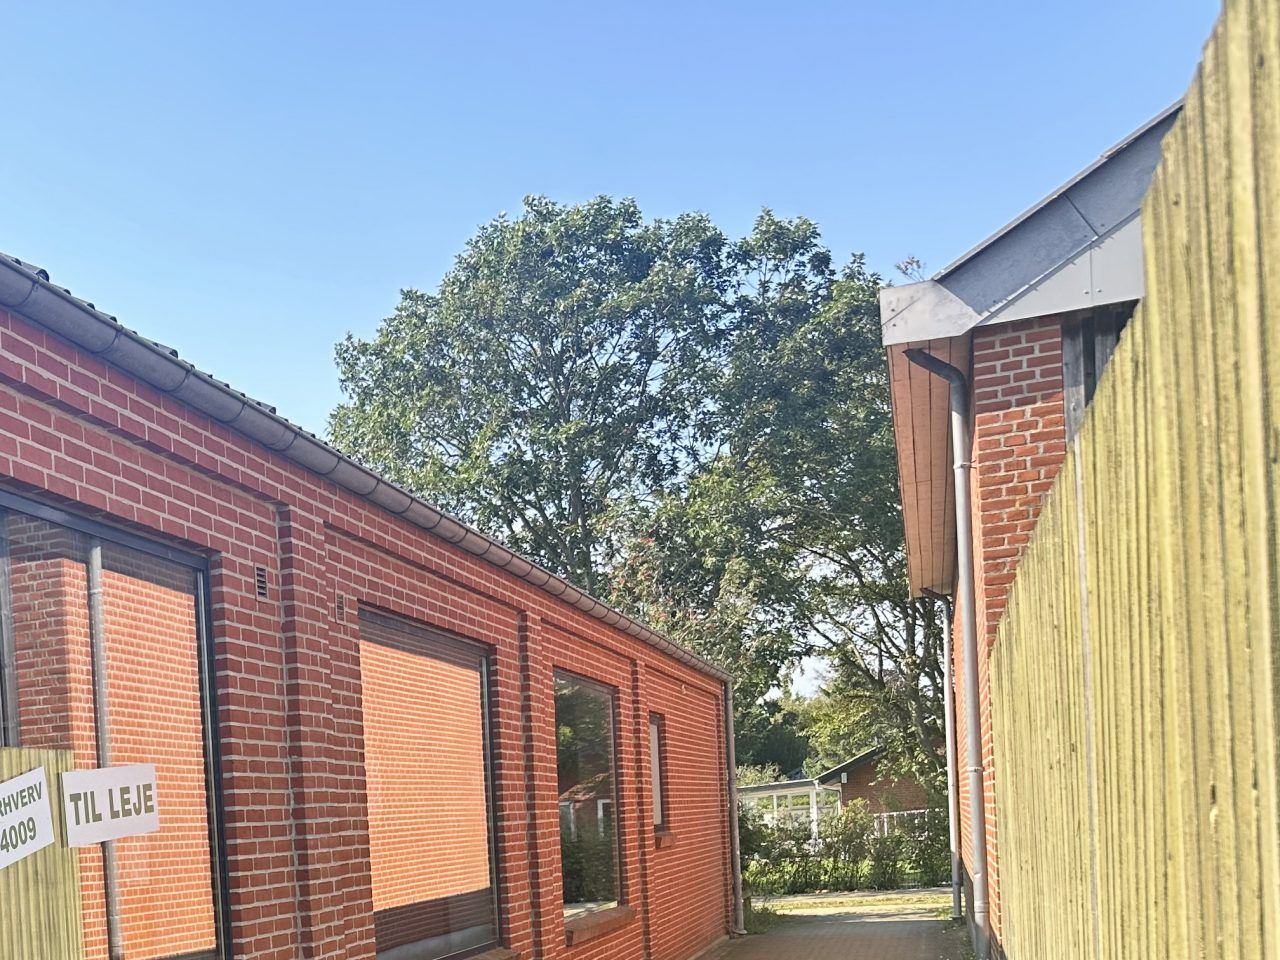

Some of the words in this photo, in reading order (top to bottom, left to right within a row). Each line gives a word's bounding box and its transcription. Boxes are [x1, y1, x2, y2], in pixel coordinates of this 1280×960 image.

[69, 792, 102, 825] TIL
[108, 783, 155, 820] LEJE
[0, 816, 37, 854] 4009
